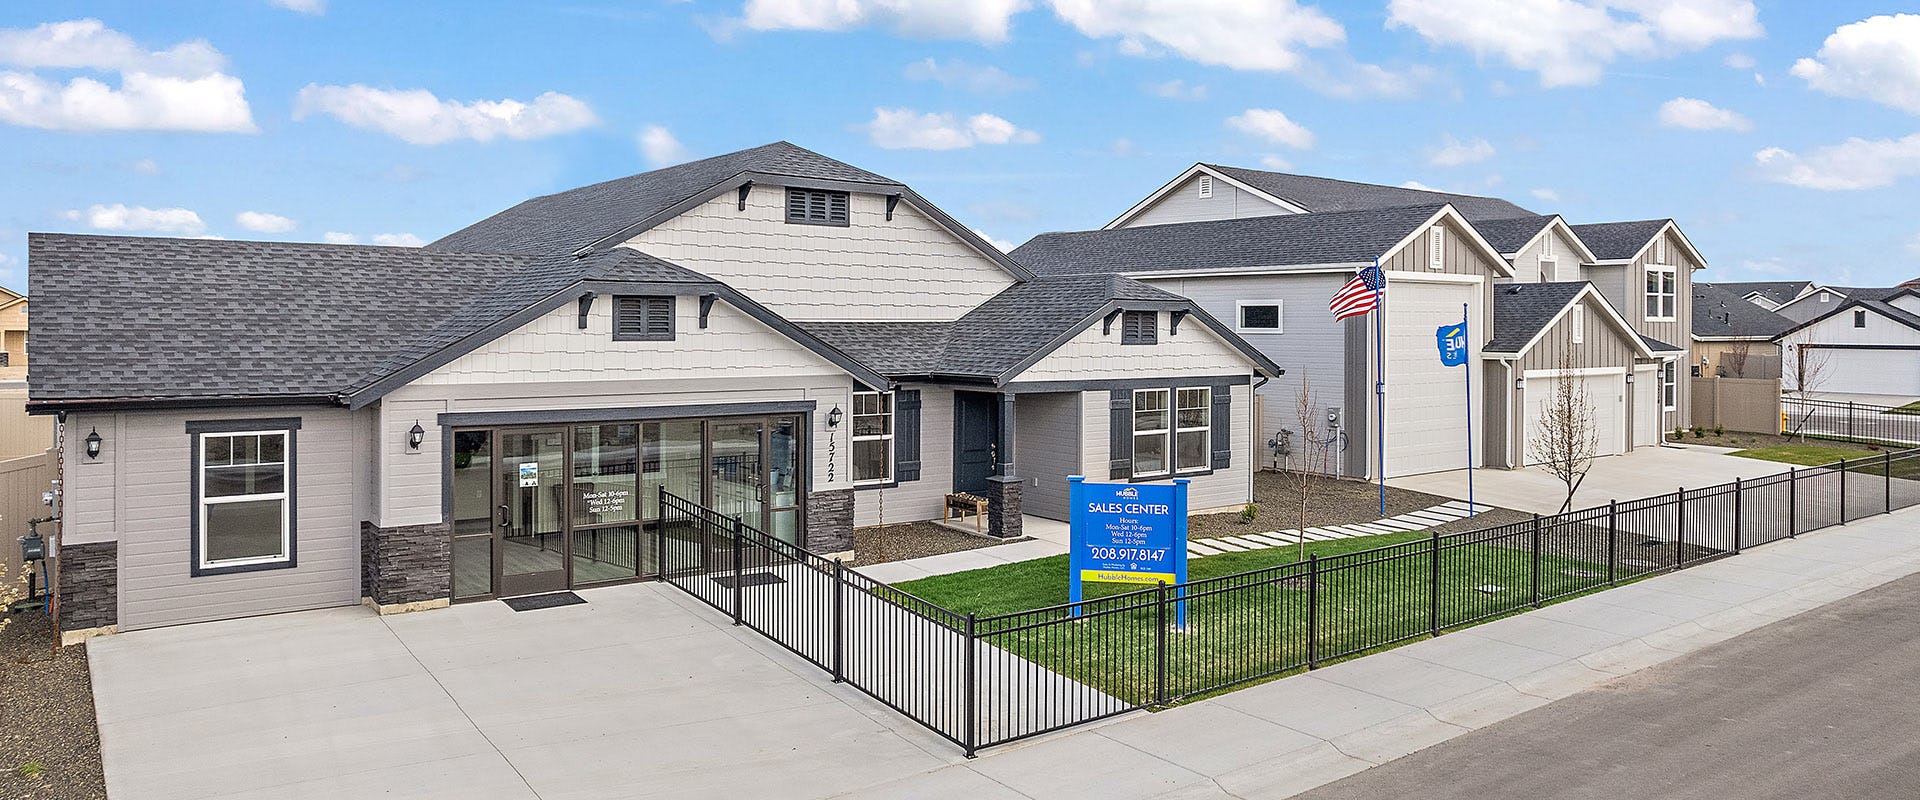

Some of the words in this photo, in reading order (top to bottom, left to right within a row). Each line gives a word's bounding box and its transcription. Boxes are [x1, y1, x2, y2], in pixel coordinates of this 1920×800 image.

[828, 432, 836, 483] 15722
[1088, 502, 1123, 514] SALES
[1124, 503, 1169, 515] CENTER
[1131, 525, 1153, 533] 10-6pm
[1125, 531, 1148, 539] 12-6pm
[1124, 538, 1146, 546] 12-5pm
[1091, 547, 1165, 562] 208.917.8147
